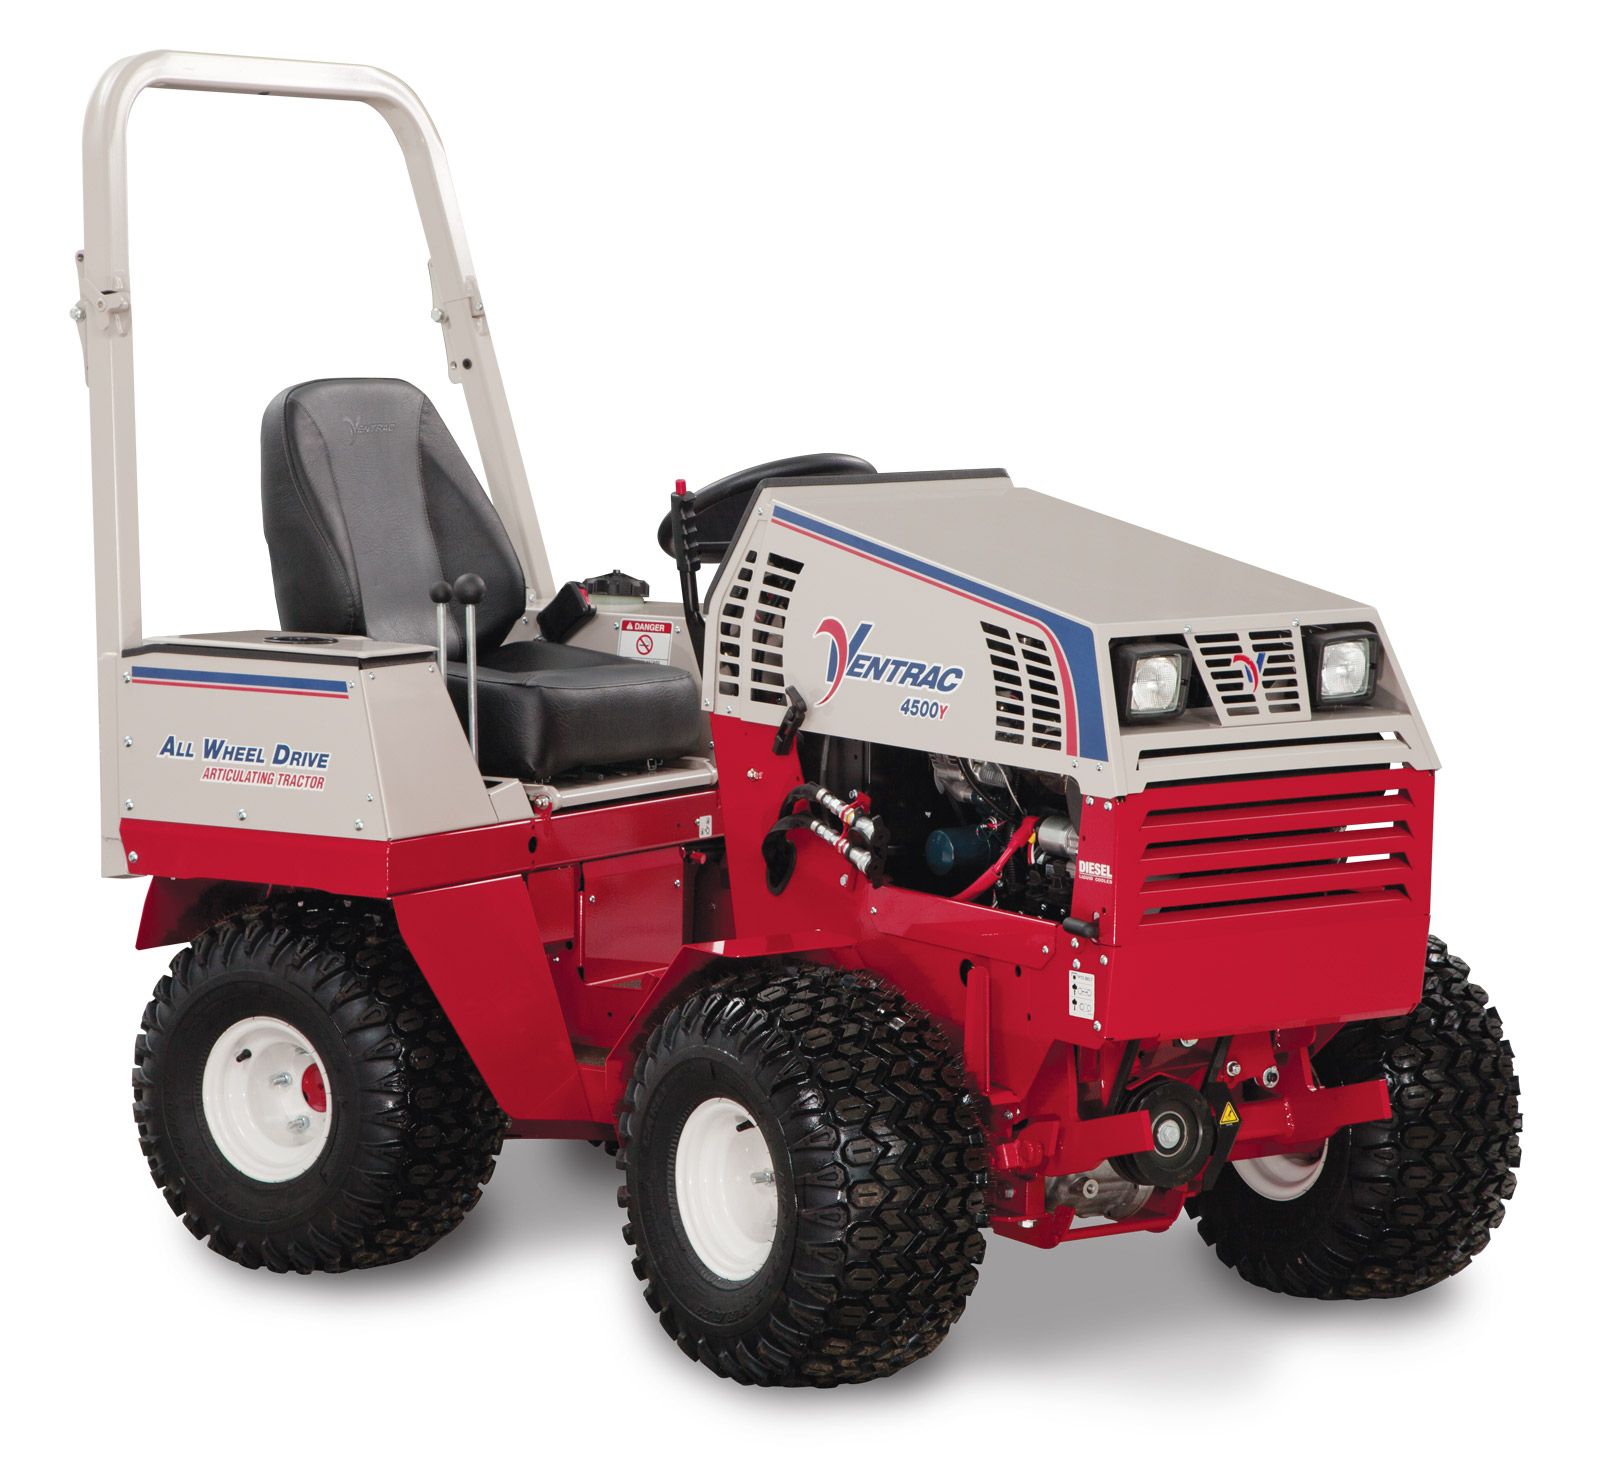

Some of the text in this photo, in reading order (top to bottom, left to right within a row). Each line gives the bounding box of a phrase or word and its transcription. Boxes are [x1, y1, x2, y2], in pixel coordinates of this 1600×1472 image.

[634, 623, 665, 632] DANGER
[813, 617, 965, 706] VENTRAC
[900, 698, 949, 720] 4500Y
[202, 767, 326, 790] ARTICULATING TRACTOR
[1078, 860, 1113, 880] DIESEL
